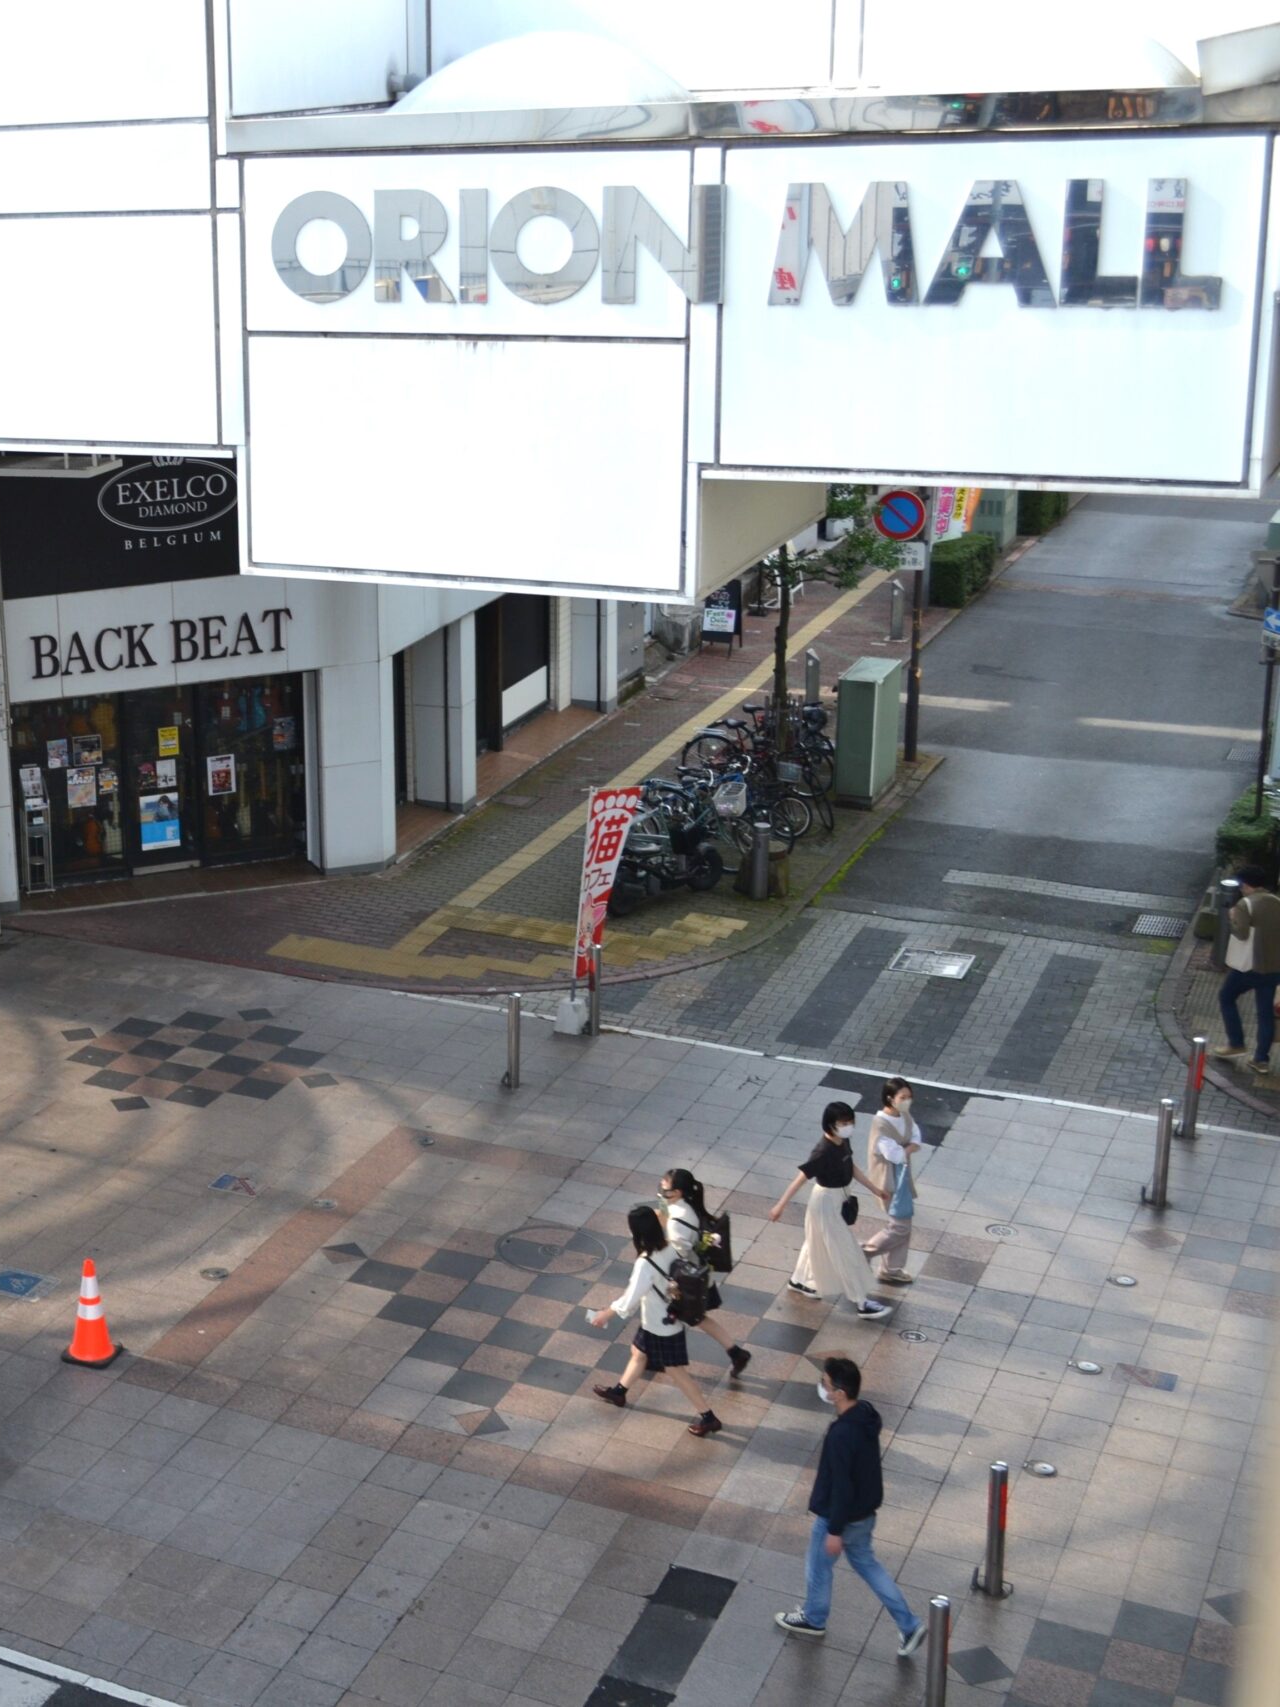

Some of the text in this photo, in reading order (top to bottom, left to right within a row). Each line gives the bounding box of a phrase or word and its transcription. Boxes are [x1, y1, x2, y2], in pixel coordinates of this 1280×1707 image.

[271, 184, 725, 306] ORION
[766, 177, 1224, 311] MALL
[116, 473, 228, 506] EXELCO
[138, 501, 208, 519] DIAMOND
[124, 530, 222, 551] BELGIUM
[30, 608, 293, 680] BACK BEAT
[585, 813, 629, 869] 猫
